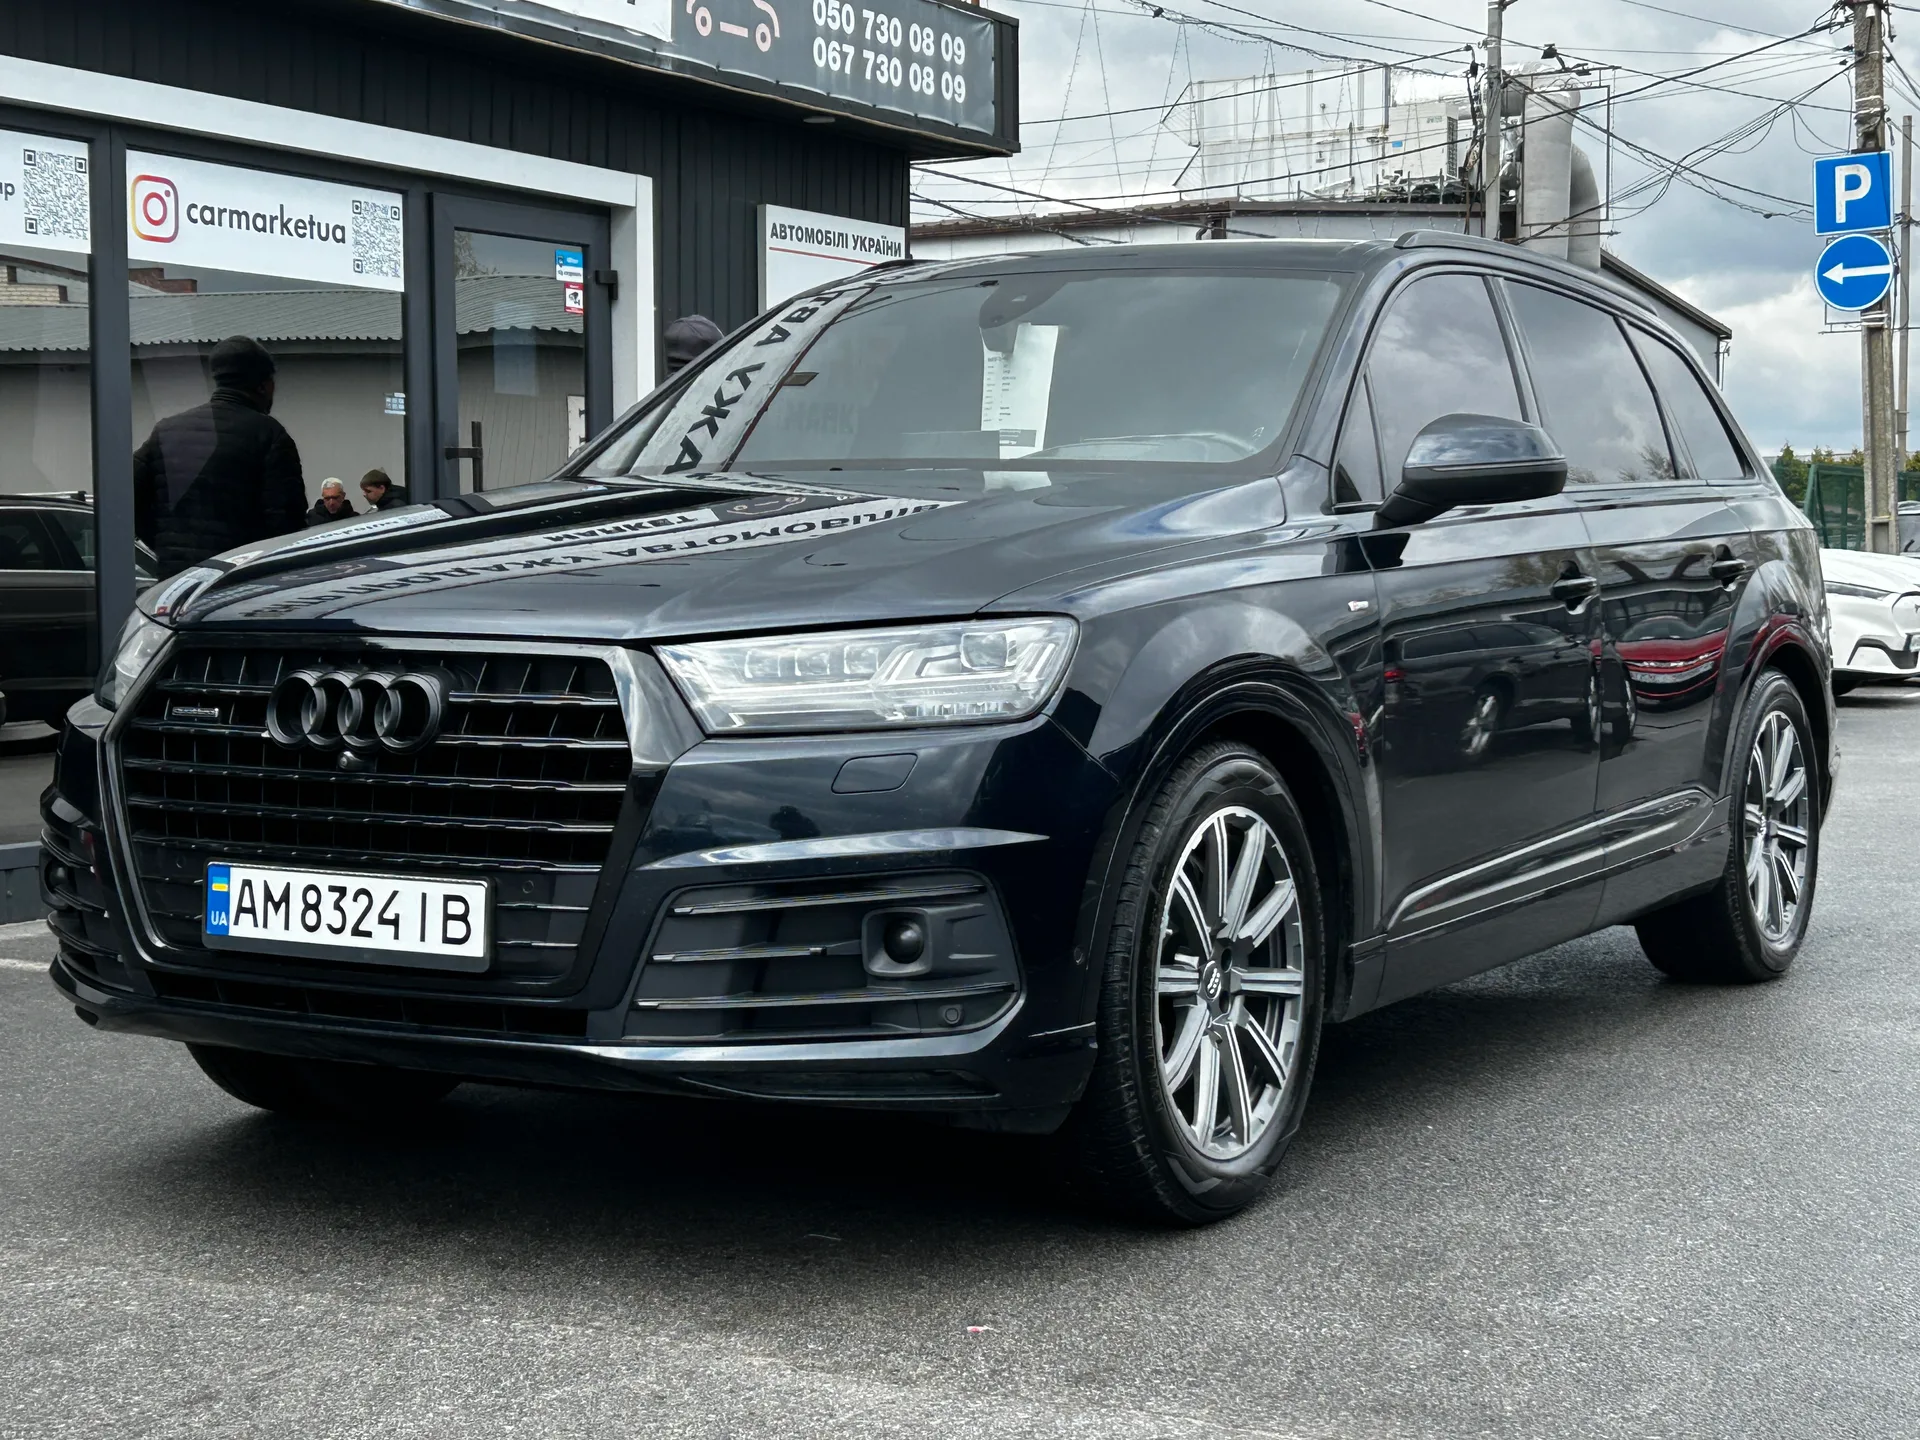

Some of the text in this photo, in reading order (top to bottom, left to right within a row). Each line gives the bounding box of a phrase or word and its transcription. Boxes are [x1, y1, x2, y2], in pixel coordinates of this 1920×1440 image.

[813, 0, 965, 65] 050 730 08 09
[813, 37, 966, 103] 067 730 08 09
[1835, 164, 1871, 223] P
[186, 203, 346, 244] carmarketua
[770, 222, 901, 257] АВТОМОБІЛІ УКРАЇНИ
[211, 911, 228, 926] UA
[301, 884, 400, 940] 8324
